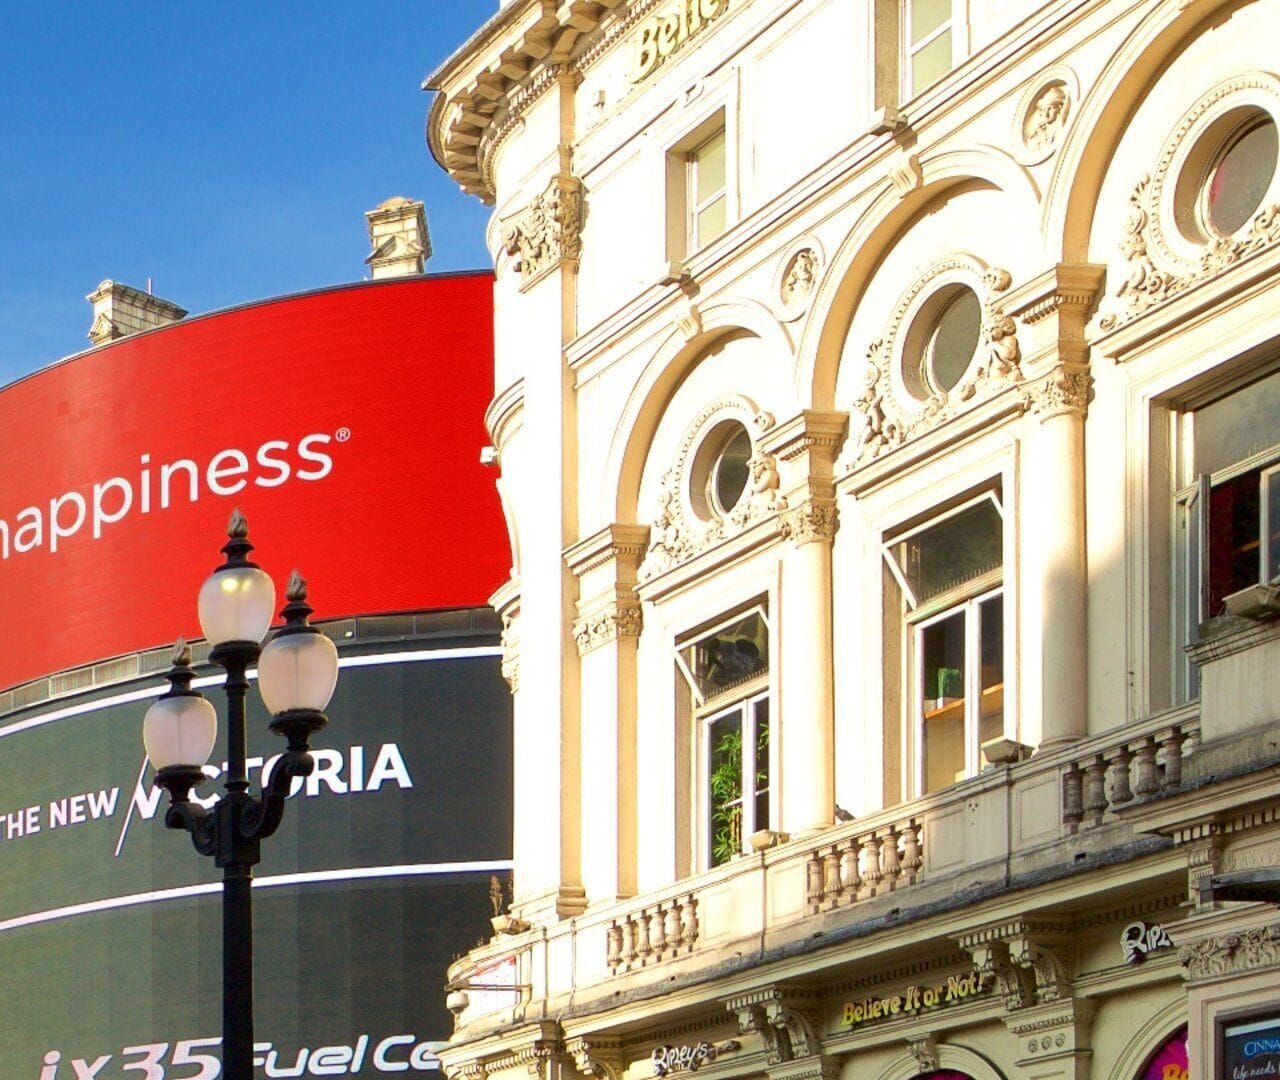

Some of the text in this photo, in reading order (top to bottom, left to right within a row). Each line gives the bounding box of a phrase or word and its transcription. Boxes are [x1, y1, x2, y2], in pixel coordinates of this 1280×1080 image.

[49, 788, 120, 829] NEW
[116, 742, 414, 856] VCRIA
[842, 994, 900, 1026] Believe
[904, 985, 921, 1011] It
[924, 987, 942, 1008] or
[945, 973, 986, 1002] Not!
